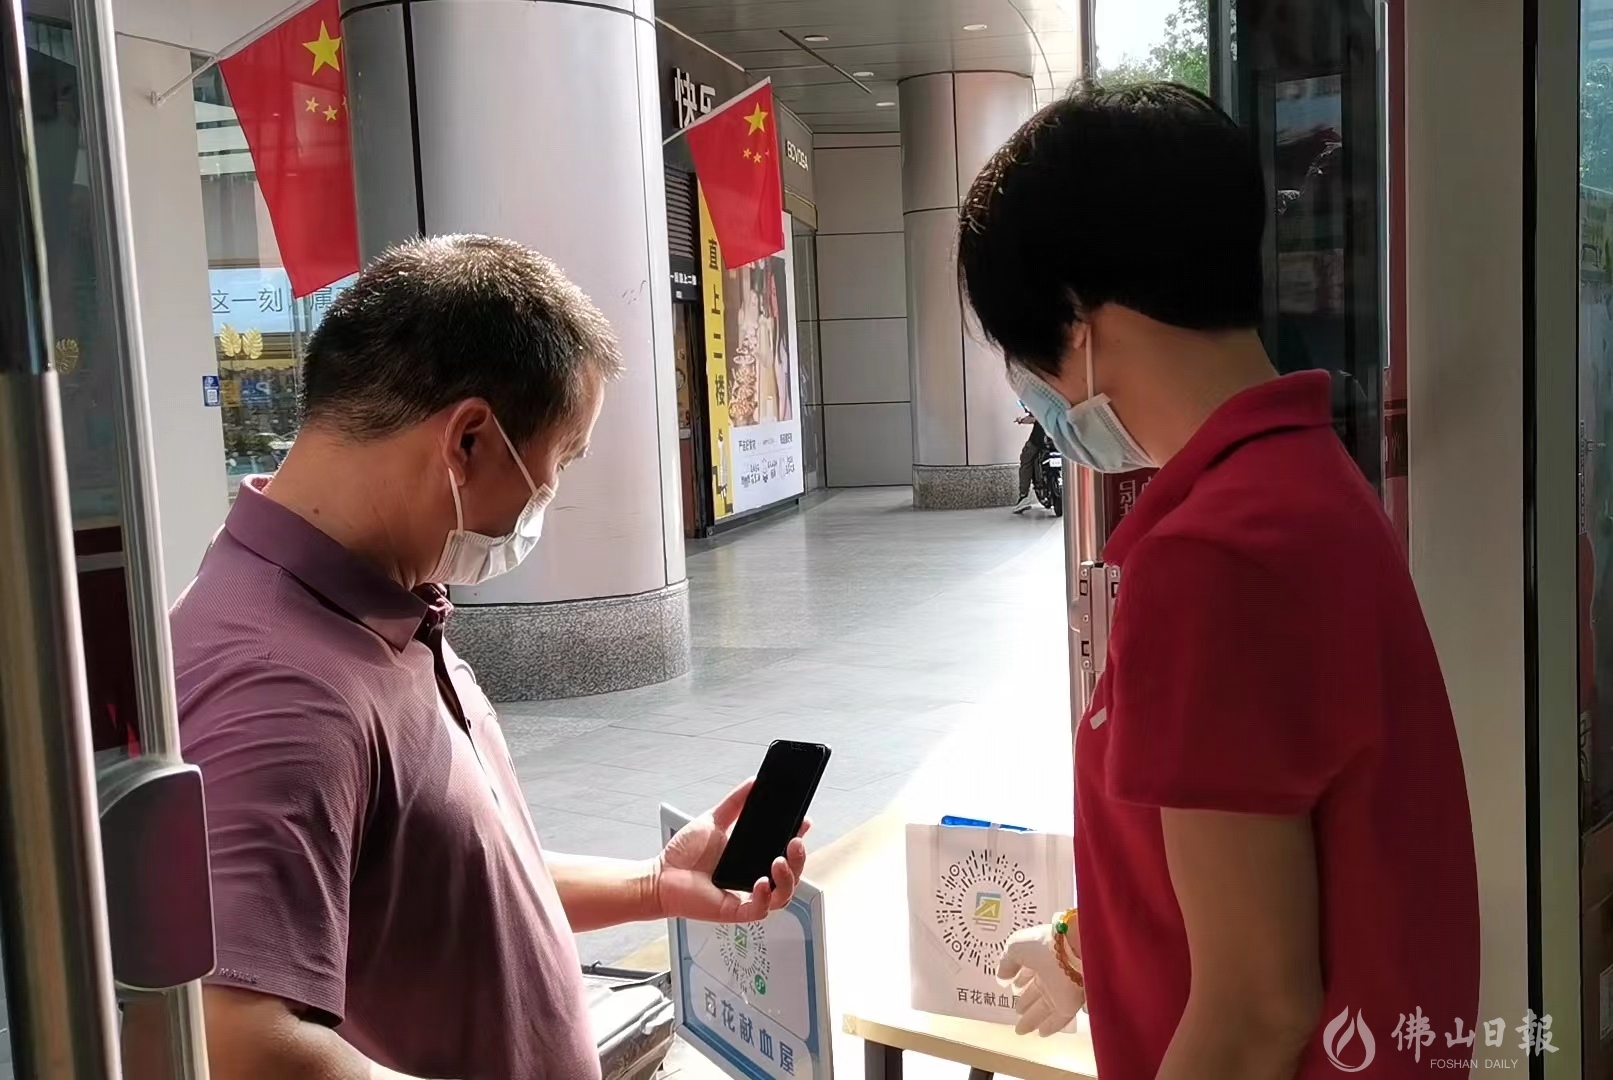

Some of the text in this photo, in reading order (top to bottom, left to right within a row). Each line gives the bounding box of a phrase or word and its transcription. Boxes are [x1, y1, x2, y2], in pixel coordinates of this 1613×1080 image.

[708, 237, 726, 406] 直上二楼
[704, 985, 795, 1077] 百花献血屋
